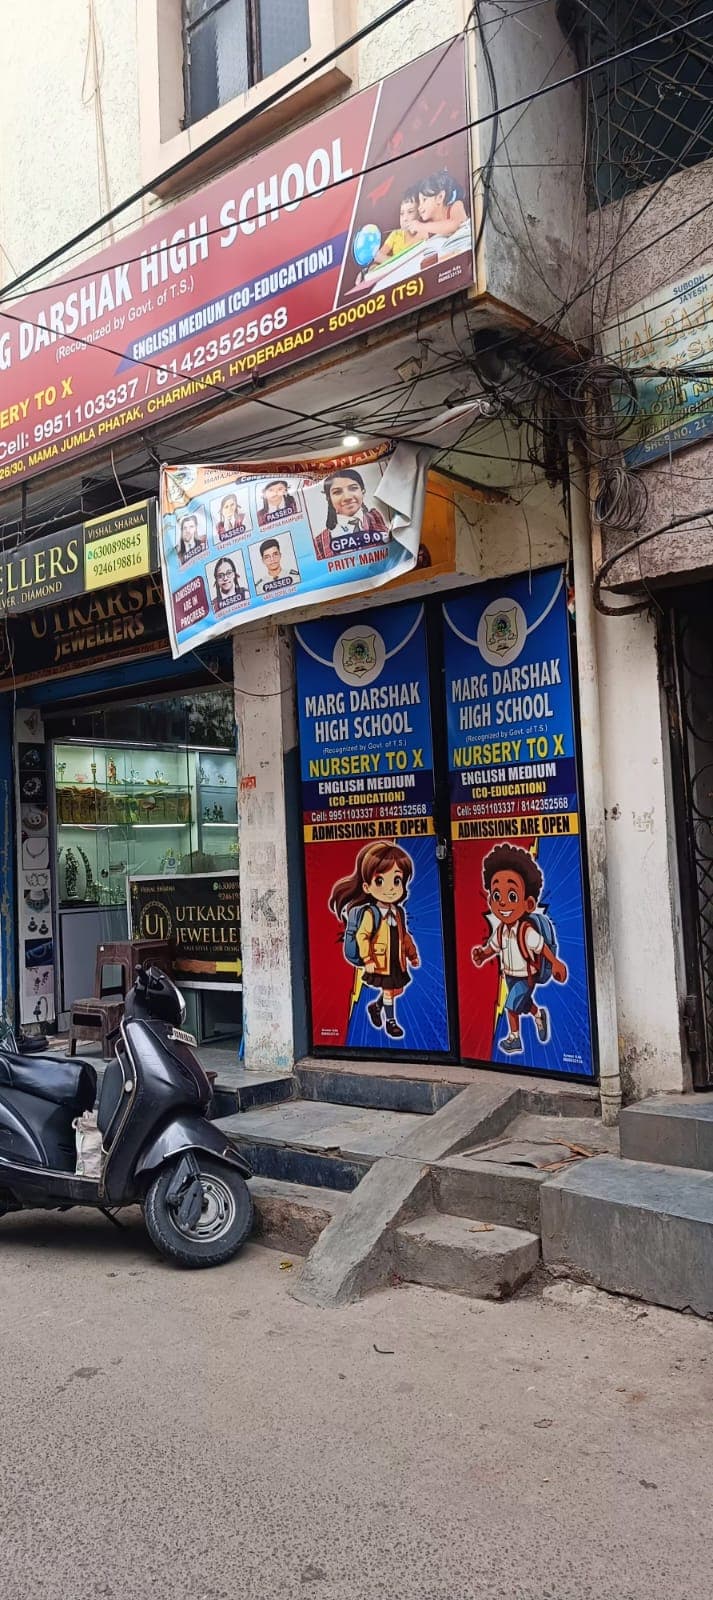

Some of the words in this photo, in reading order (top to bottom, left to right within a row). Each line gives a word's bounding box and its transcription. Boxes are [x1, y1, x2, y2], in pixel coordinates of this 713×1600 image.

[19, 262, 133, 362] DARSHAK
[140, 213, 210, 296] HIGH
[219, 138, 354, 249] SCHOOL
[672, 274, 705, 295] SUBODH
[680, 284, 708, 304] JAYESH
[132, 328, 178, 361] ENGLISH
[178, 301, 226, 350] MEDIUM
[228, 245, 334, 315] (CO-EDUCATION)
[55, 323, 112, 363] (Recognized
[113, 316, 126, 333] by
[127, 298, 154, 323] Govt.
[156, 288, 169, 307] of
[169, 276, 195, 303] T.S.)
[28, 445, 59, 467] MAMA
[61, 429, 96, 453] JUMLA
[97, 406, 144, 436] PHATAK,
[146, 371, 226, 414] CHARMINAR,
[229, 327, 314, 377] HYDERABAD
[328, 294, 386, 332] 500002
[391, 277, 425, 307] (TS)
[33, 377, 140, 443] 9951103337
[156, 306, 289, 386] 8142352568
[34, 386, 57, 411] TO
[61, 377, 74, 399] X
[266, 507, 293, 521] PASSED
[87, 524, 113, 540] VISHAL
[114, 513, 145, 532] SHARMA
[221, 526, 245, 540] PASSED
[93, 533, 141, 559] 6300898845
[331, 536, 361, 552] GPA:
[93, 554, 142, 576] 9246198816
[327, 556, 356, 573] PRITY
[21, 581, 63, 603] DIAMOND
[265, 578, 292, 591] PASSED
[219, 594, 243, 608] PASSED
[181, 606, 206, 628] PROGRESS
[54, 613, 145, 662] JEWELLERS
[451, 673, 488, 704] MARG
[492, 657, 562, 695] DARSHAK
[305, 693, 346, 718] MARG
[350, 681, 421, 713] DARSHAK
[459, 702, 491, 731] HIGH
[495, 692, 554, 725] SCHOOL
[315, 718, 349, 743] HIGH
[353, 711, 414, 739] SCHOOL
[453, 739, 522, 769] NURSERY
[526, 736, 548, 759] TO
[552, 733, 566, 756] X
[309, 752, 381, 778] NURSERY
[385, 750, 408, 771] TO
[412, 749, 425, 769] X
[461, 768, 506, 786] ENGLISH
[508, 762, 557, 782] MEDIUM
[318, 779, 365, 796] ENGLISH
[366, 774, 416, 791] MEDIUM
[471, 781, 546, 800] (CO-EDUCATION)
[328, 791, 406, 808] (CO-EDUCATION)
[456, 804, 472, 817] Cell:
[472, 800, 516, 816] 9951103337
[521, 796, 569, 812] 8142352568
[311, 811, 327, 823] Cell:
[328, 807, 374, 822] 9951103337
[379, 803, 427, 818] 8142352568
[312, 821, 377, 841] ADMISSIONS
[378, 820, 398, 837] ARE
[400, 818, 428, 835] OPEN
[458, 817, 519, 839] ADMISSIONS
[519, 816, 541, 835] ARE
[542, 815, 570, 833] OPEN
[175, 927, 241, 946] JEWELLE
